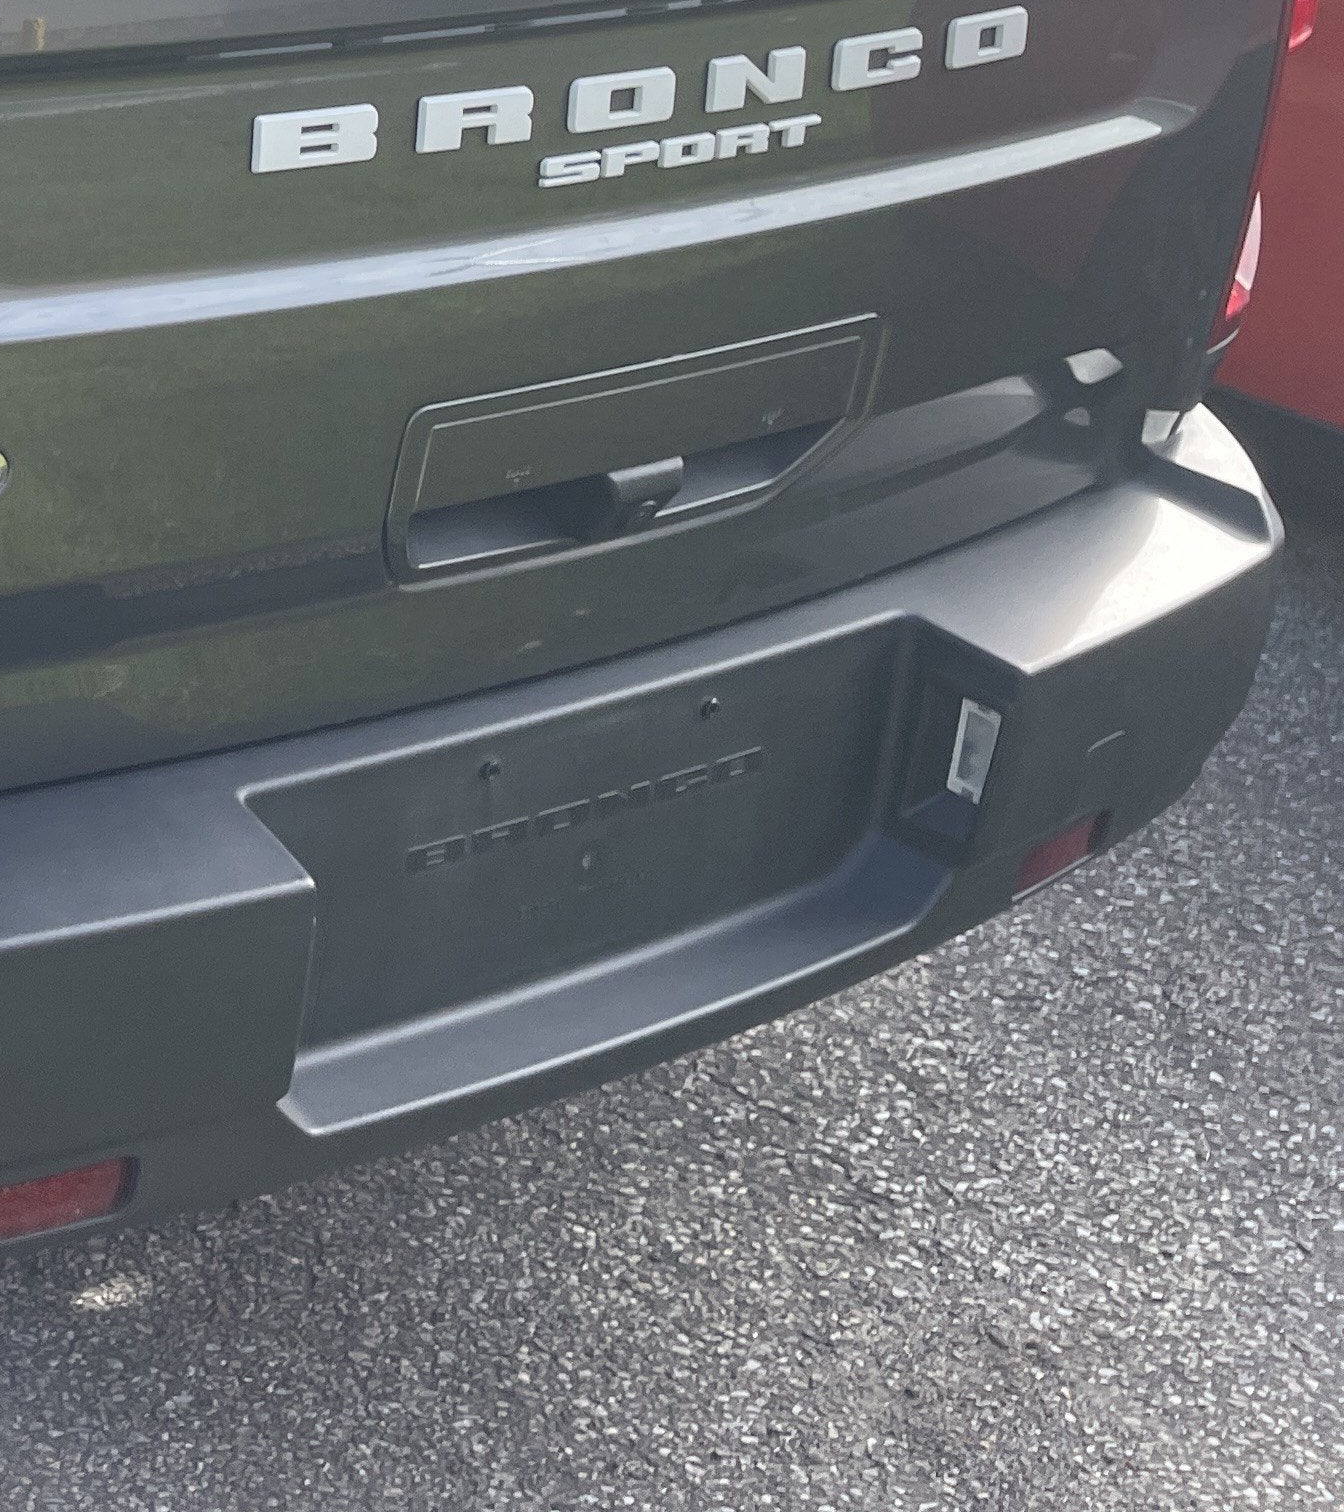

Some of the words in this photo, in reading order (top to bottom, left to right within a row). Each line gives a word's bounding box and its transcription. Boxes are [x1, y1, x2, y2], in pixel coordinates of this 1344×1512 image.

[251, 5, 1029, 174] BRONCO
[538, 113, 823, 188] SPORT
[405, 745, 762, 874] BRONCO
